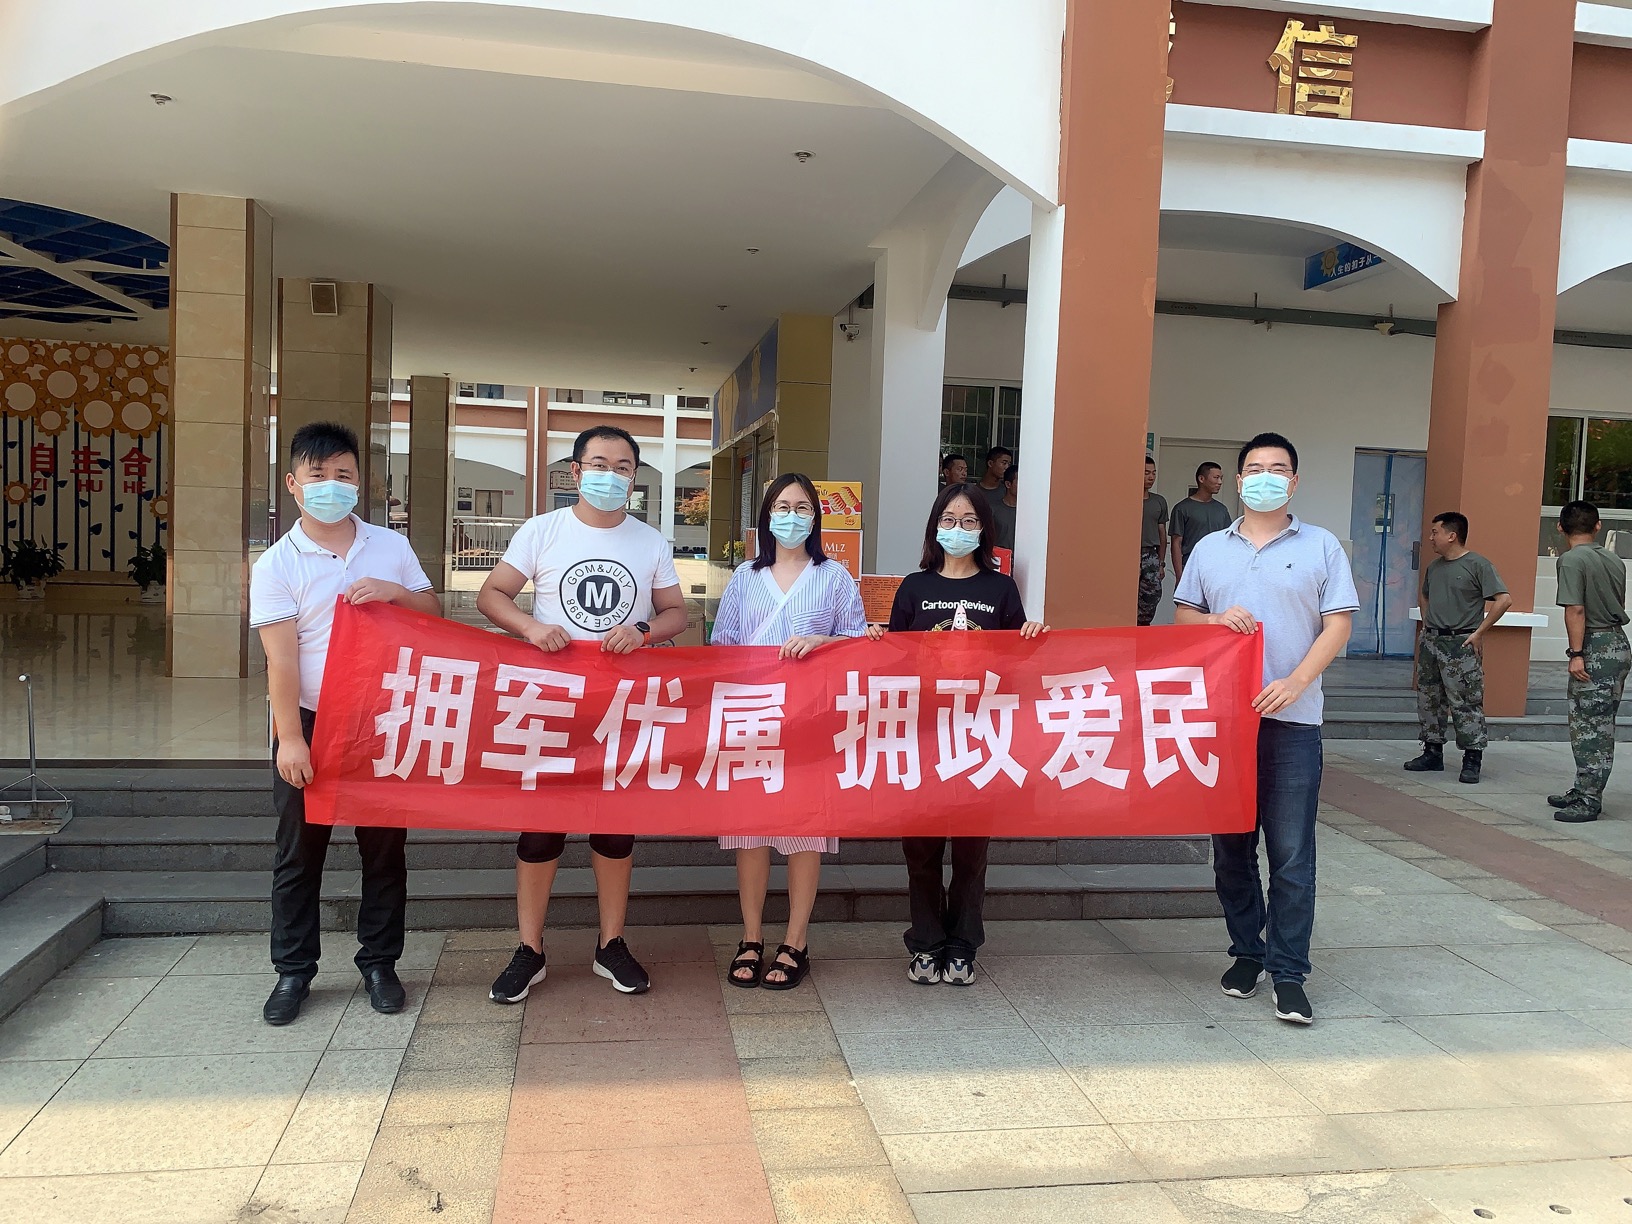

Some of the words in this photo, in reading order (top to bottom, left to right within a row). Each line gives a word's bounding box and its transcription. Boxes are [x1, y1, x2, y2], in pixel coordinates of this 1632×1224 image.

[1267, 18, 1358, 119] 信
[30, 443, 152, 477] 自主合
[567, 564, 632, 589] GOM&JULY
[585, 581, 613, 609] M
[566, 598, 589, 624] 1998
[594, 601, 630, 628] SINCE
[371, 646, 786, 794] 拥军优属
[835, 665, 1220, 792] 拥政爱民
